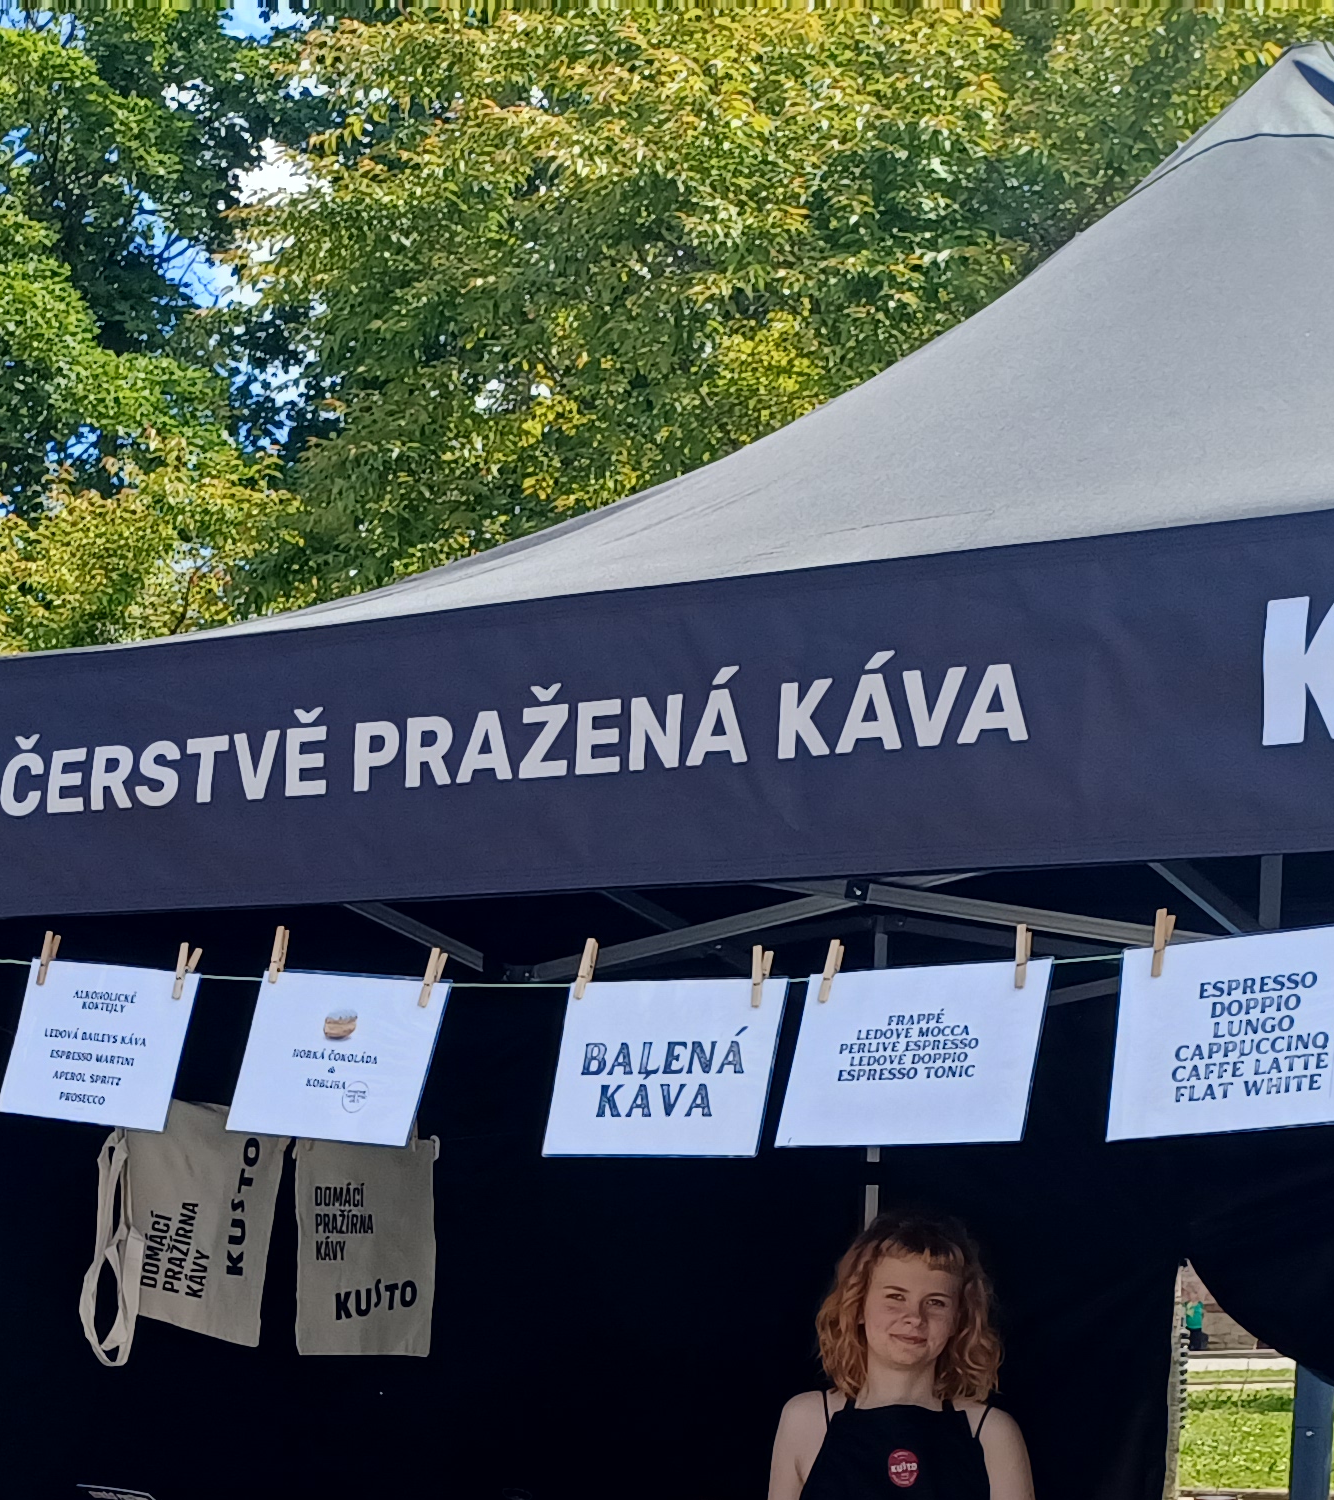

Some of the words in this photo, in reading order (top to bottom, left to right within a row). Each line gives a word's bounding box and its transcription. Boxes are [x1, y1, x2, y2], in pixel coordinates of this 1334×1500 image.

[0, 707, 328, 818] ČERSTVĚ
[353, 666, 748, 793] PRAŽENÁ
[777, 650, 1029, 760] KÁVA
[1198, 971, 1318, 999] ESPRESSO
[81, 1001, 127, 1013] KOKTEJLY
[887, 1008, 945, 1026] FRAPPÉ
[1210, 993, 1302, 1018] DOPPIO
[44, 1028, 80, 1041] LEDOVÁ
[81, 1031, 118, 1045] BAILEYS
[120, 1033, 147, 1047] KÁVA
[917, 1024, 970, 1038] MOCCA
[1212, 1014, 1295, 1038] LUNGO
[291, 1048, 326, 1060] HORKÁ
[328, 1049, 378, 1065] ČOKOLÁDA
[580, 1025, 749, 1076] BALENÁ
[905, 1037, 979, 1052] ESPRESSO
[1174, 1031, 1330, 1062] CAPPUCCINO
[49, 1049, 92, 1062] ESPRESSO
[95, 1053, 135, 1067] MARTINI
[911, 1051, 968, 1065] DOPPIO
[52, 1070, 86, 1083] APEROL
[89, 1074, 121, 1086] SPRITZ
[305, 1077, 347, 1090] KOBLIHA
[837, 1067, 918, 1082] ESPRESSO
[924, 1065, 976, 1079] TONIC
[58, 1091, 106, 1105] PROSECCO
[595, 1073, 713, 1118] KÁVA
[1174, 1082, 1234, 1103] FLAT
[1243, 1073, 1322, 1097] WHITE
[226, 1137, 261, 1277] KUSTO
[314, 1181, 366, 1208] DOMÁCÍ
[314, 1209, 374, 1235] PRAŽÍRNA
[140, 1210, 173, 1289] DOMÁCÍ
[162, 1201, 199, 1294] PRAŽÍRNA
[315, 1236, 347, 1262] KÁVY
[184, 1249, 210, 1300] KÁVY
[335, 1278, 418, 1321] KUSTO
